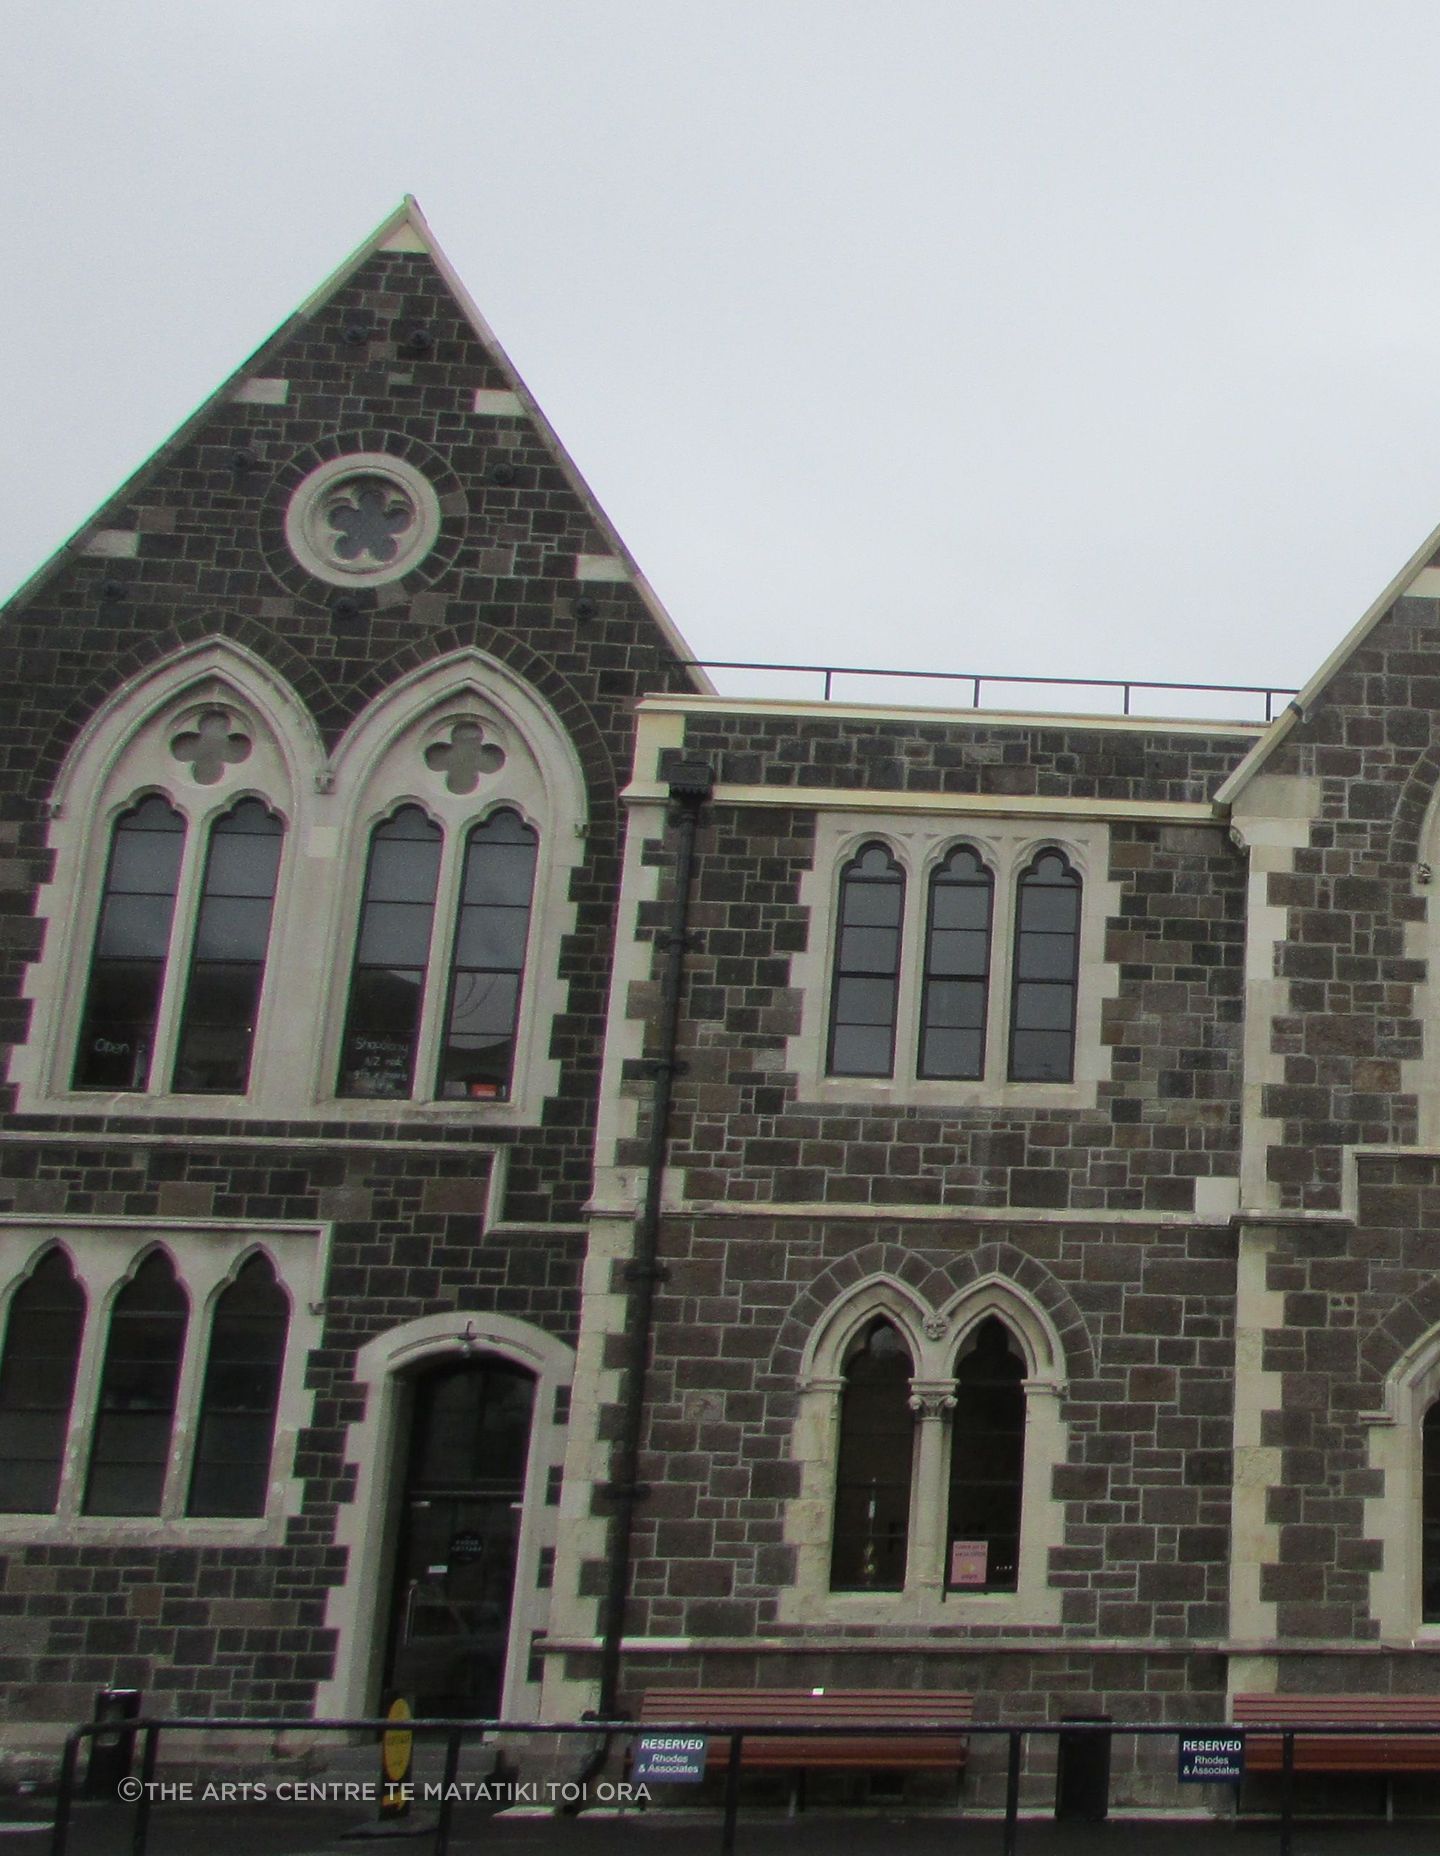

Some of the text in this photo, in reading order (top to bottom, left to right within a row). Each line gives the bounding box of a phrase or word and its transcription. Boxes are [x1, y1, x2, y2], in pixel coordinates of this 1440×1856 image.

[95, 1038, 130, 1054] Open
[641, 1739, 704, 1750] RESERVED
[1183, 1740, 1242, 1751] RESERVED
[652, 1753, 689, 1763] Rhodes
[1194, 1755, 1229, 1764] Rhodes
[639, 1763, 699, 1773] & Associates
[1183, 1765, 1240, 1775] & Associates
